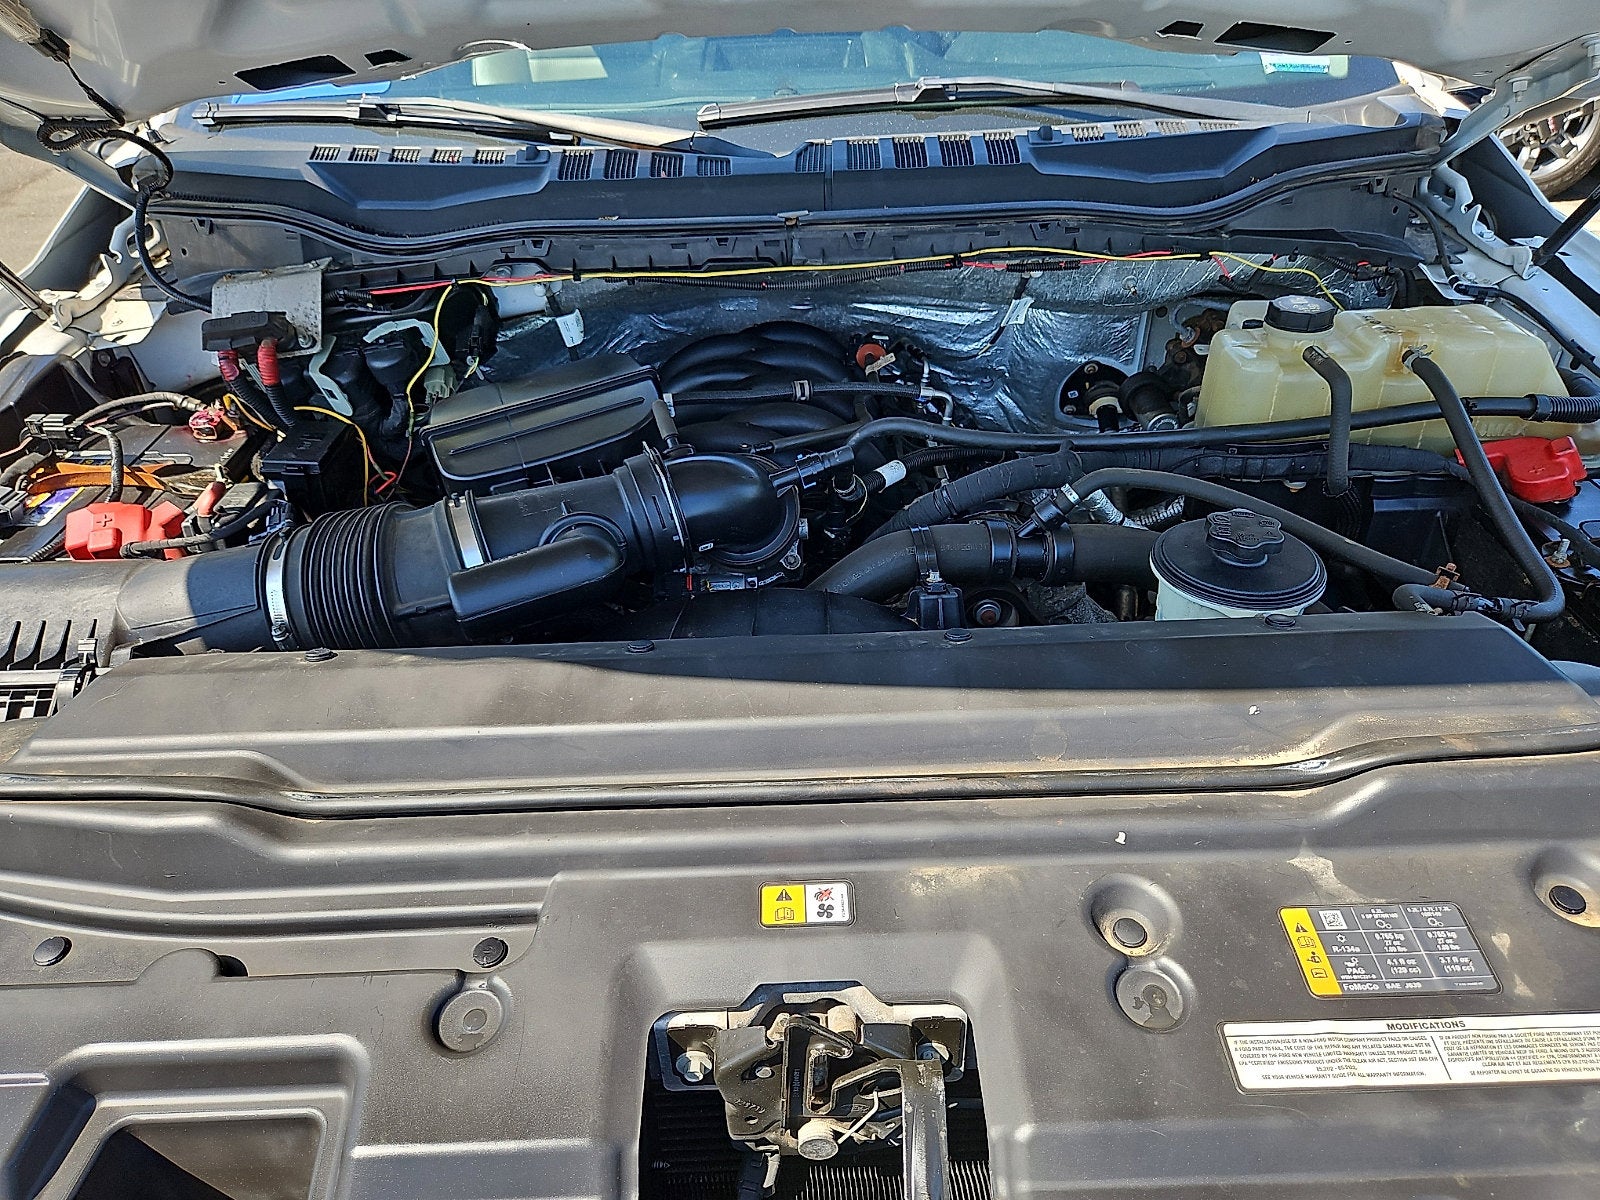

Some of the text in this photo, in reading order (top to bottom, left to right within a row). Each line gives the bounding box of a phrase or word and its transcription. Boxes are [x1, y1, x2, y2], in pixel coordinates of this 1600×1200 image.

[1408, 966, 1421, 974] cc)
[1461, 965, 1474, 973] cc)
[1343, 983, 1379, 991] FoMoCo
[1386, 1020, 1466, 1031] MODIFICATIONS
